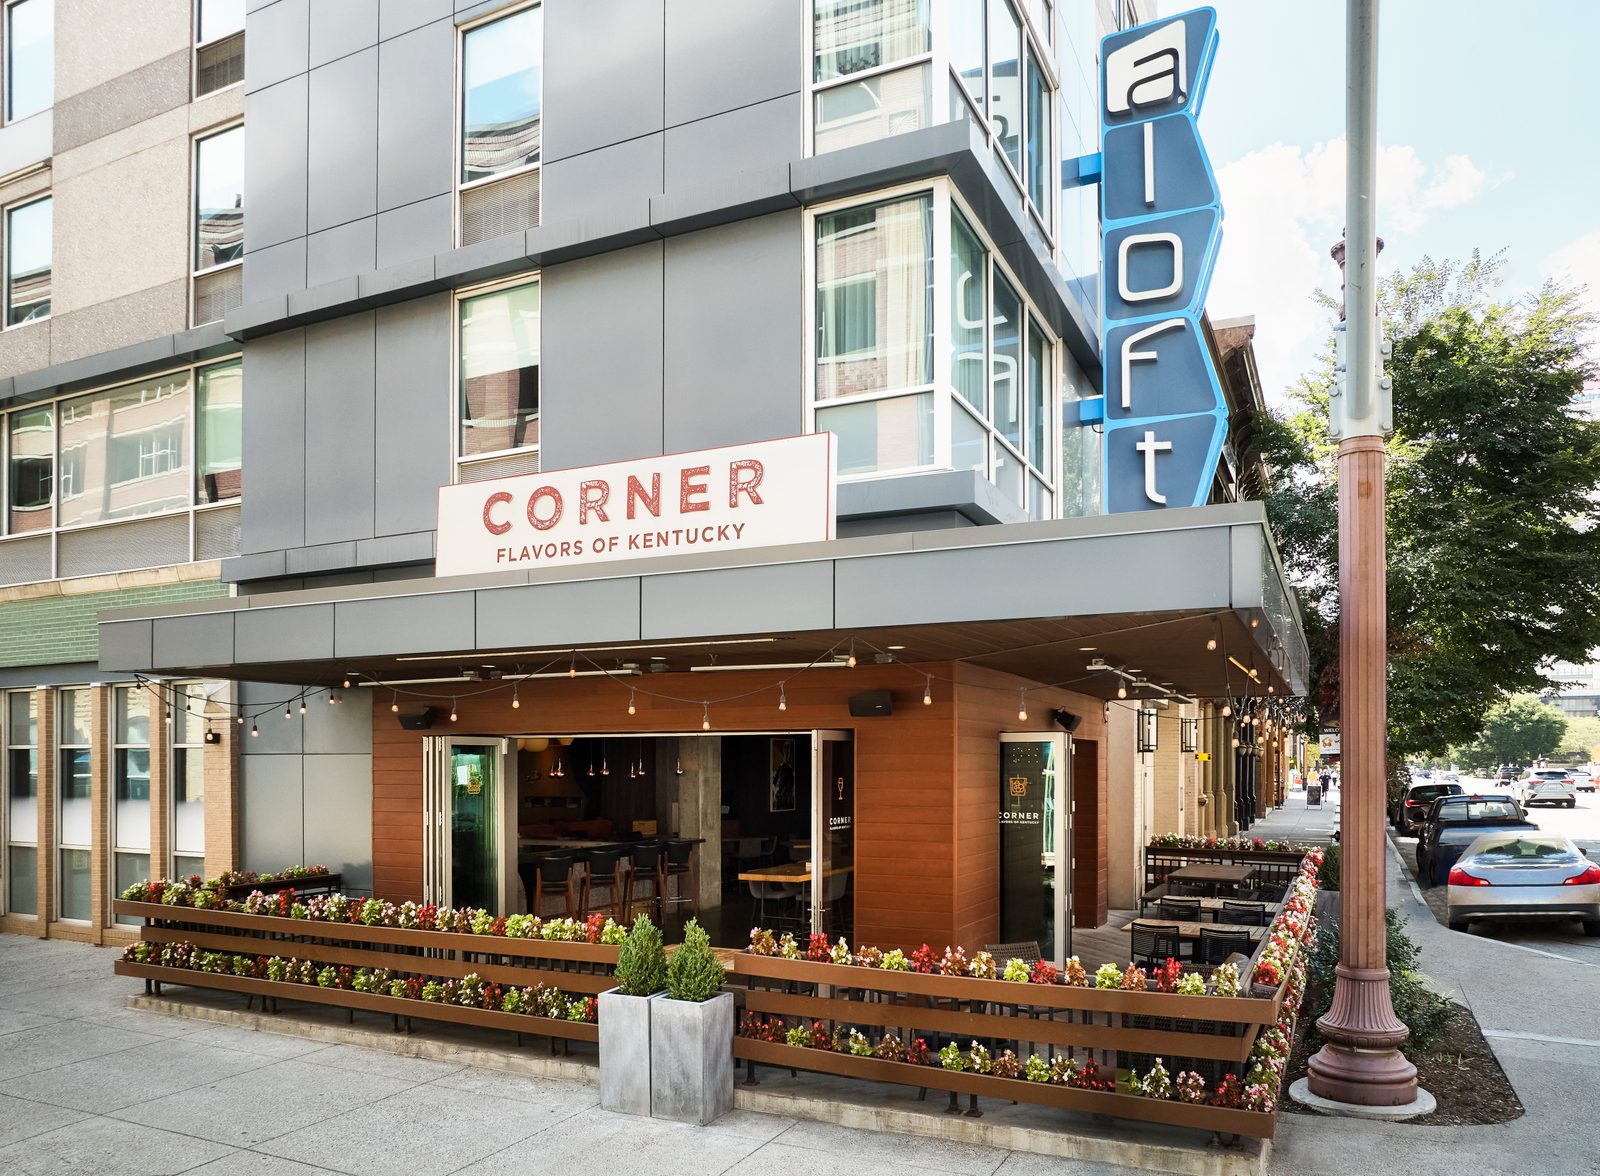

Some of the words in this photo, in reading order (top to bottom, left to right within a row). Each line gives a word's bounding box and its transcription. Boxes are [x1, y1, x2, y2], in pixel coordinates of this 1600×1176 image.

[482, 459, 765, 536] CORNER
[496, 540, 584, 564] FLAVORS
[592, 537, 620, 554] OF
[629, 522, 746, 551] KENTUCKY
[829, 816, 851, 825] CORNER
